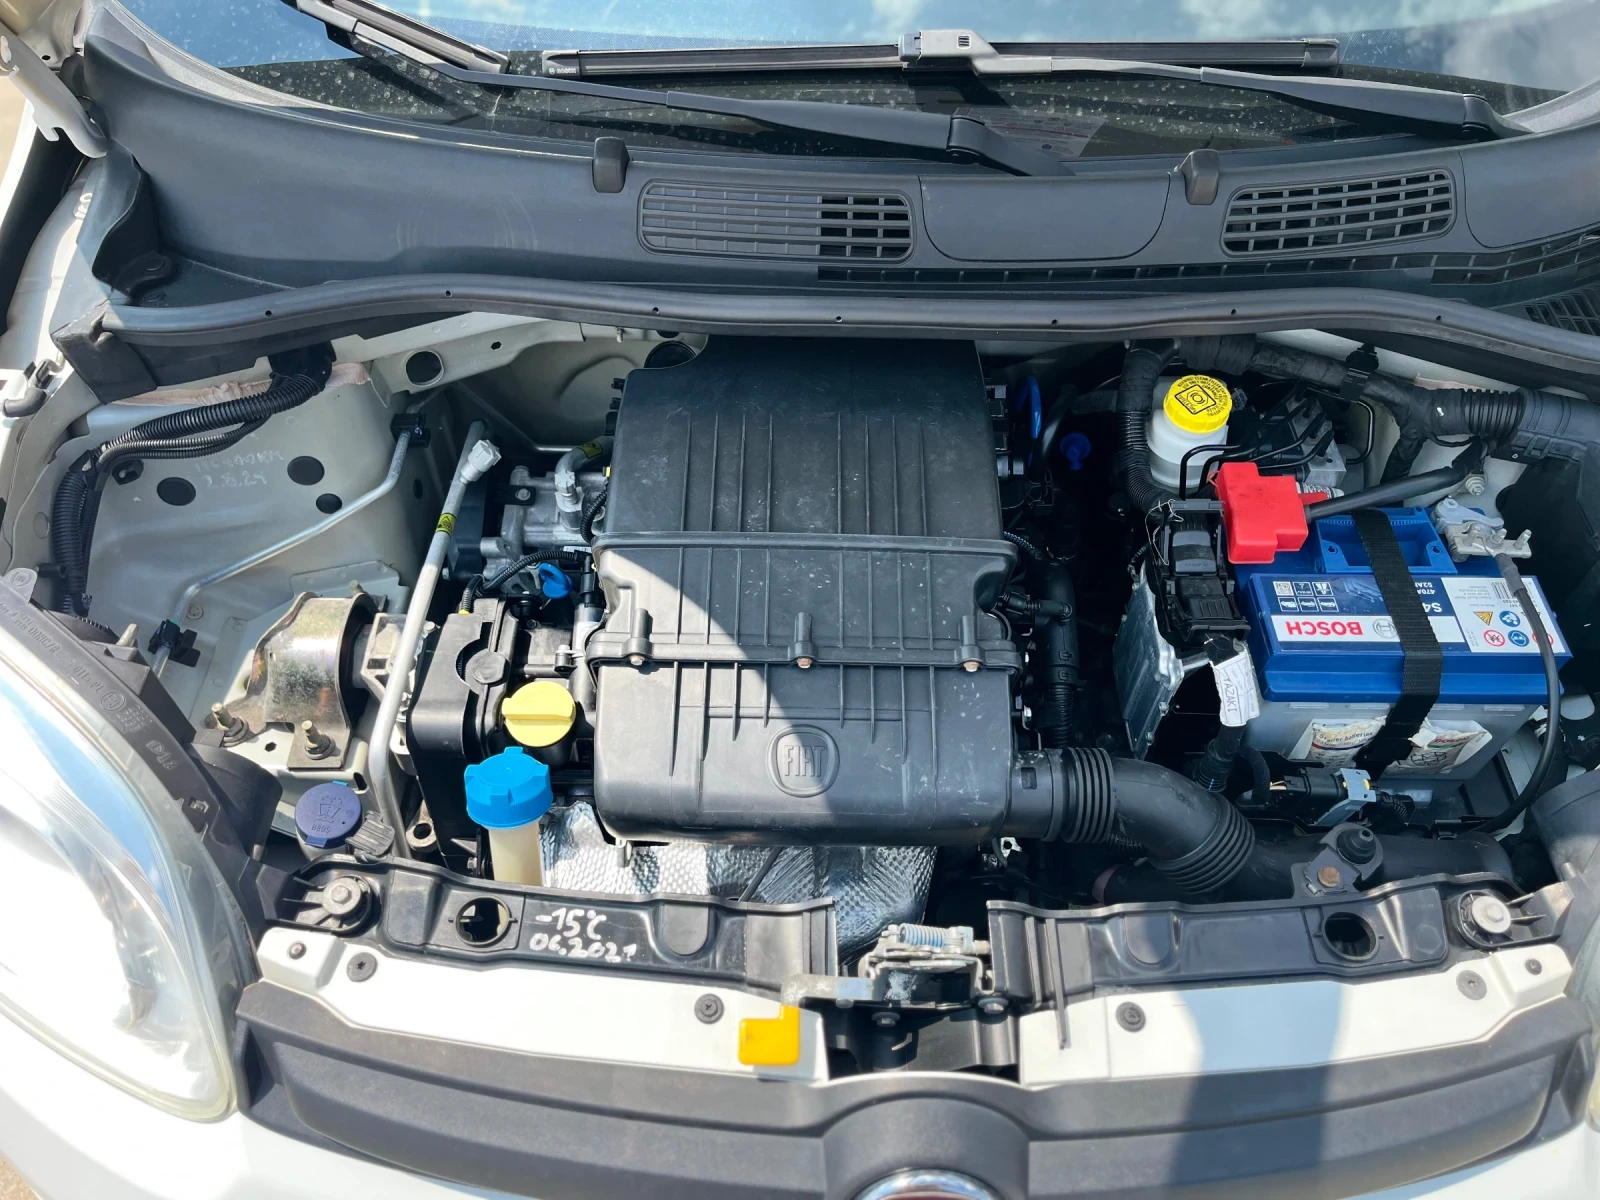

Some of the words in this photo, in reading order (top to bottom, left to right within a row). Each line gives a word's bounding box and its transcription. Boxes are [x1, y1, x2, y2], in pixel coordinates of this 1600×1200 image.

[1285, 621, 1363, 636] BOSCH
[782, 744, 826, 778] FIAT
[529, 932, 637, 963] 06.2021
